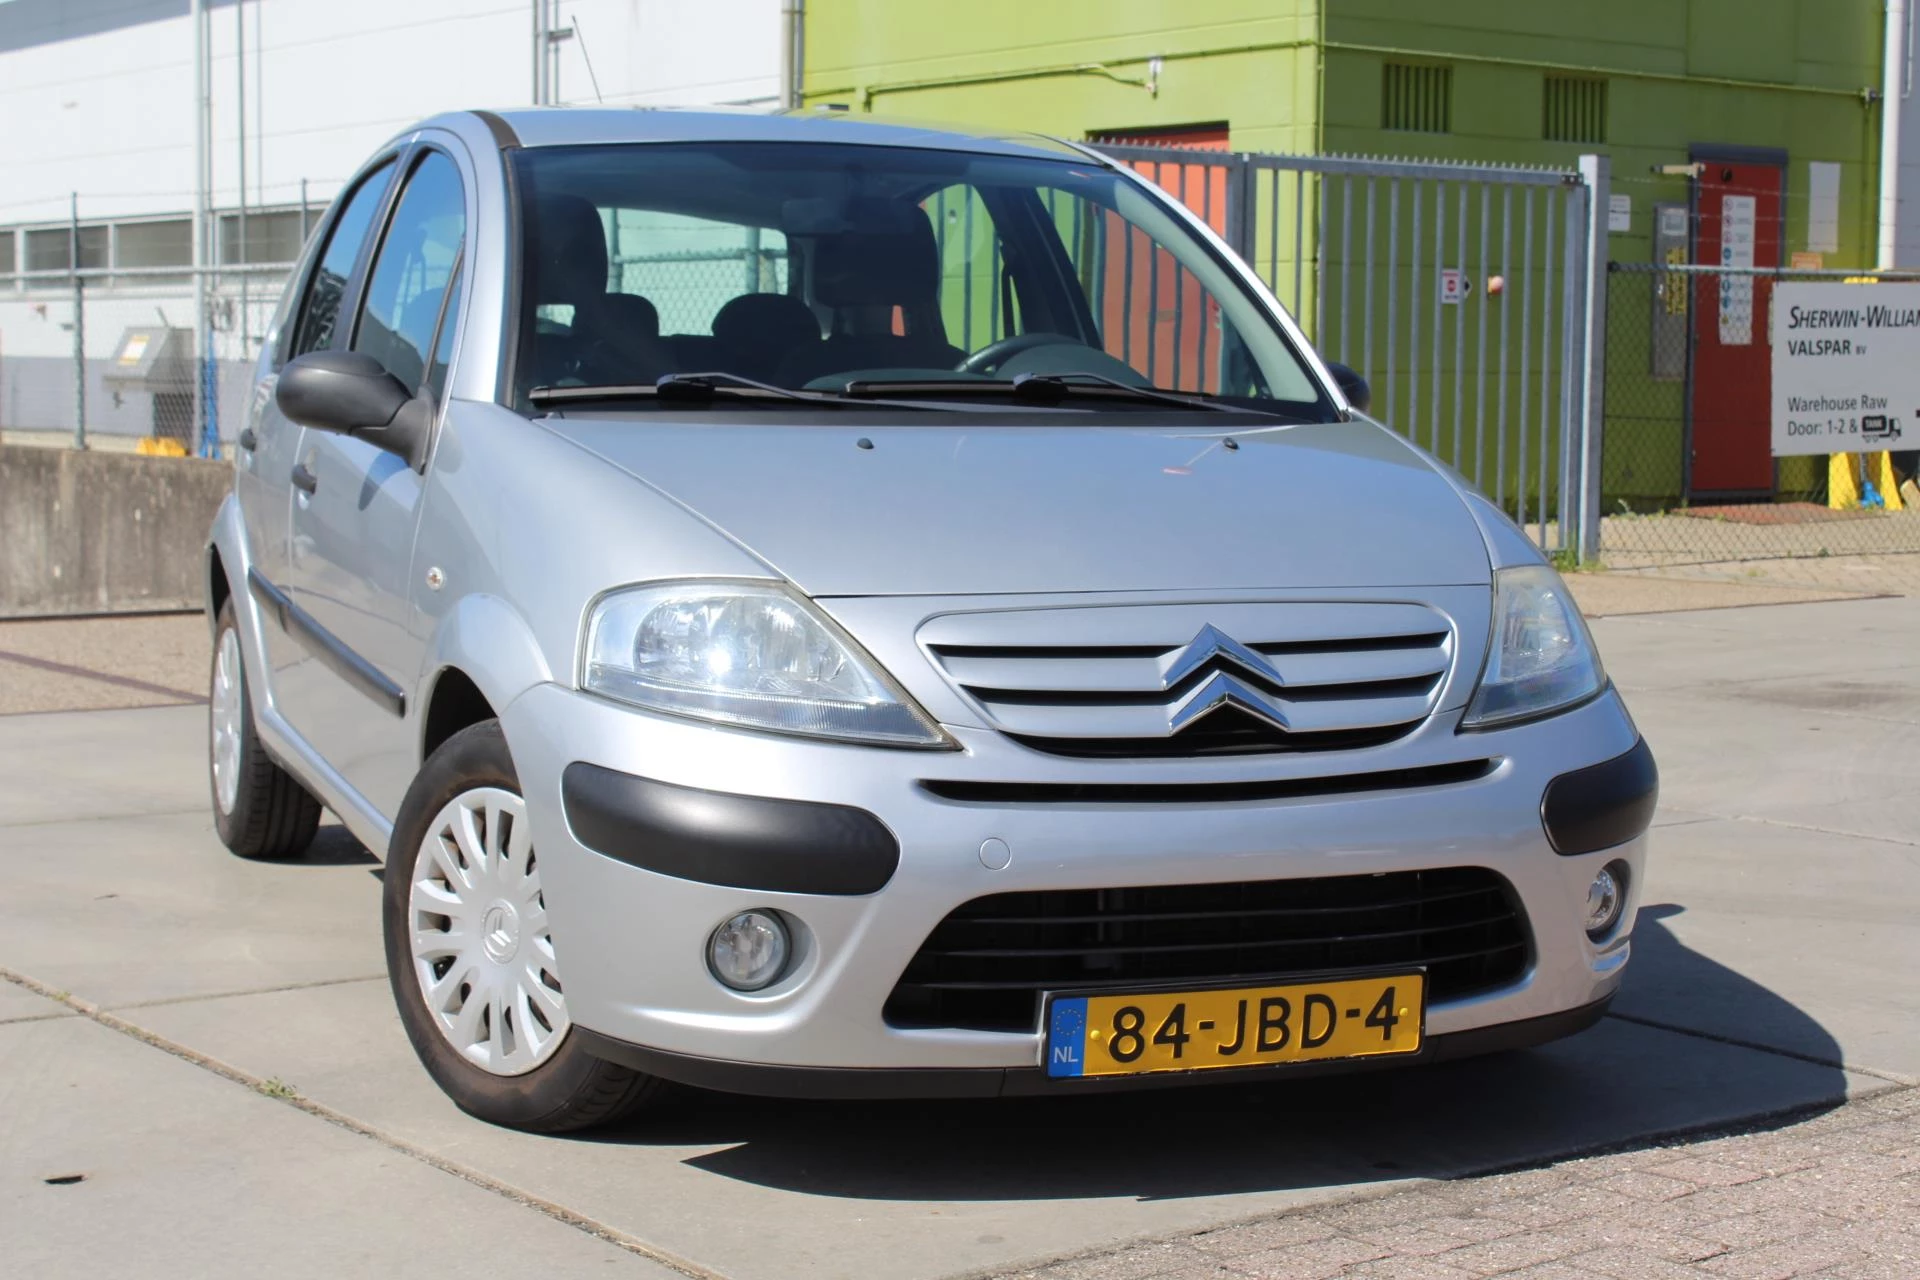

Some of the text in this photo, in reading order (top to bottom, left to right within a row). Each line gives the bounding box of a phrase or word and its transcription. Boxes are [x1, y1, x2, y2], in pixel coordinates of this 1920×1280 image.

[1788, 340, 1851, 356] VALSPAR
[1788, 395, 1888, 412] Warehouse Raw
[1788, 420, 1822, 436] Door:
[1827, 419, 1845, 434] 1-2
[1850, 419, 1858, 433] &
[1107, 986, 1400, 1063] 84-JBD-4
[1053, 1046, 1079, 1064] NL
